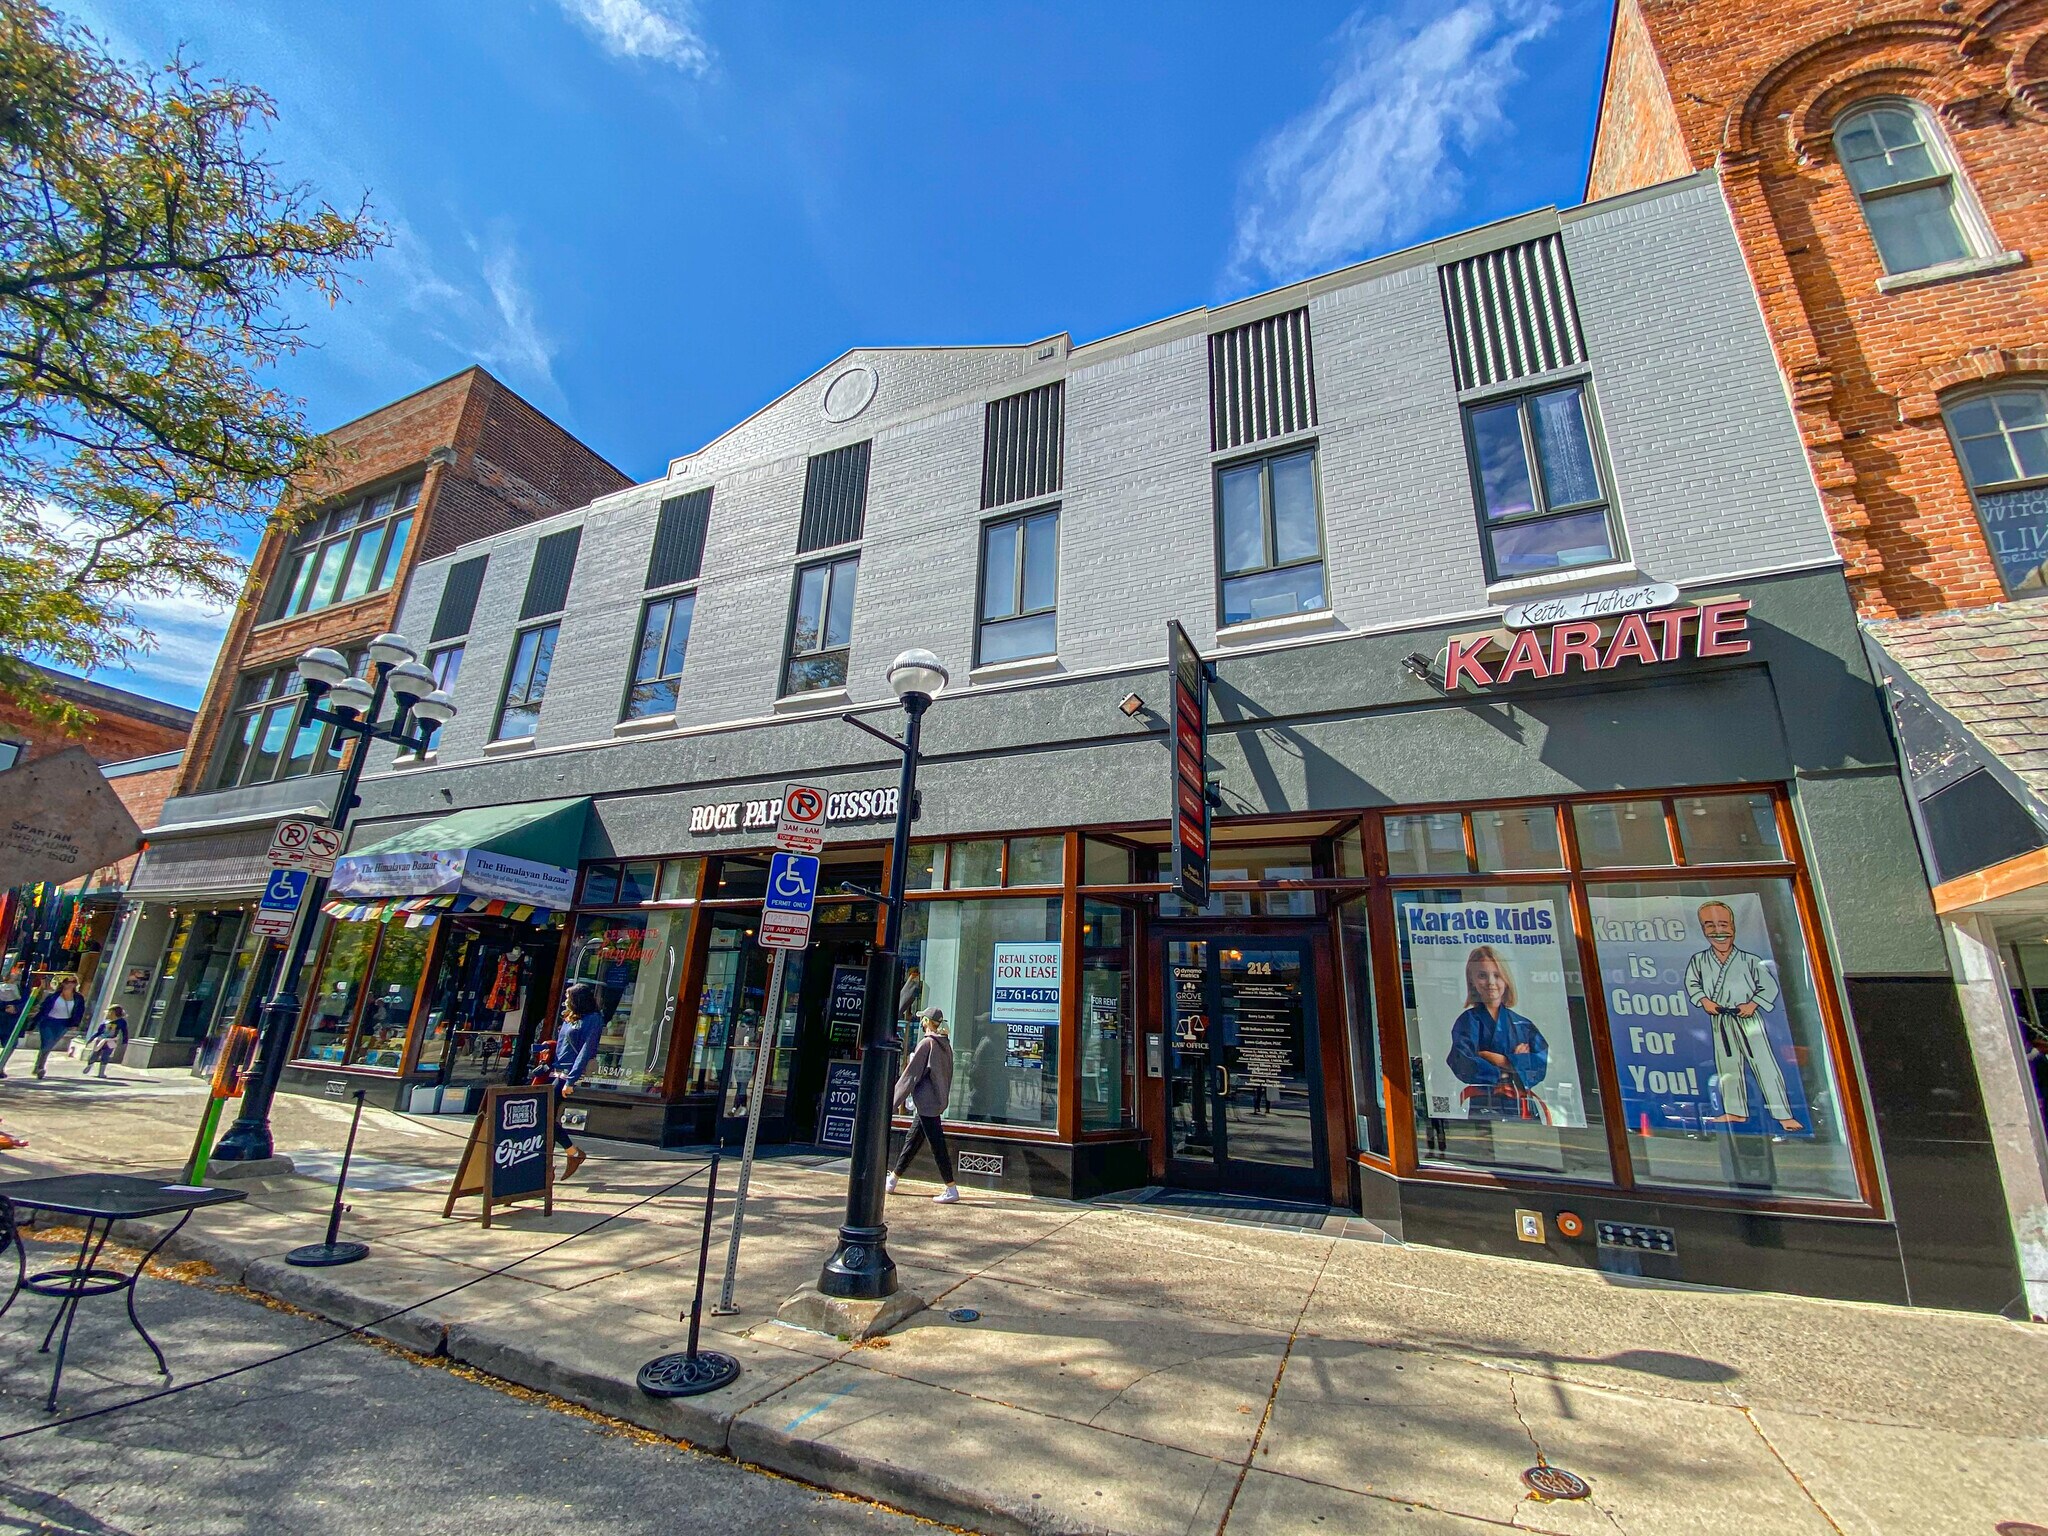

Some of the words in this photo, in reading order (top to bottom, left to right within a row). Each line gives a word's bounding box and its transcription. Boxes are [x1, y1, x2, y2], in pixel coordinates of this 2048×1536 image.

[2000, 550, 2048, 564] DELIC
[1520, 599, 1567, 625] Keith
[1581, 587, 1656, 614] Hafner's
[1443, 599, 1752, 691] KARATE
[688, 803, 742, 831] ROCK
[743, 799, 782, 827] PAP
[826, 788, 899, 820] CISSOR
[11, 820, 72, 842] SPARTAN
[784, 824, 799, 832] 3AM
[362, 864, 374, 873] The
[374, 862, 411, 873] Himalayan
[411, 861, 437, 870] Bazaar
[477, 859, 493, 870] The
[495, 863, 541, 879] Himalayan
[542, 873, 569, 885] Bazaar
[771, 899, 792, 907] PERMIT
[1409, 908, 1489, 932] Karate
[1494, 907, 1552, 931] Kids
[604, 928, 659, 940] CELEBRATE
[1592, 916, 1686, 942] Karate
[1411, 933, 1461, 945] Fearless.
[1463, 933, 1512, 944] Focused.
[1514, 933, 1555, 945] Happy.
[999, 954, 1027, 964] RETAIL
[1029, 954, 1057, 964] STORE
[1628, 952, 1657, 979] is
[998, 966, 1021, 978] FOR
[1025, 966, 1058, 978] LEASE
[1247, 962, 1271, 975] 214
[1008, 989, 1058, 1001] 761-6170
[1092, 996, 1103, 1005] FOR
[1103, 997, 1117, 1006] RENT
[1176, 992, 1202, 1000] GROVE
[836, 997, 862, 1010] STOP.
[1611, 988, 1689, 1017] Good
[1007, 1024, 1022, 1033] FOR
[1024, 1025, 1043, 1034] RENT
[1628, 1026, 1677, 1055] For
[609, 1066, 626, 1077] 24/7
[1628, 1065, 1700, 1096] You!
[830, 1091, 856, 1105] STOP.
[495, 1135, 544, 1167] Open
